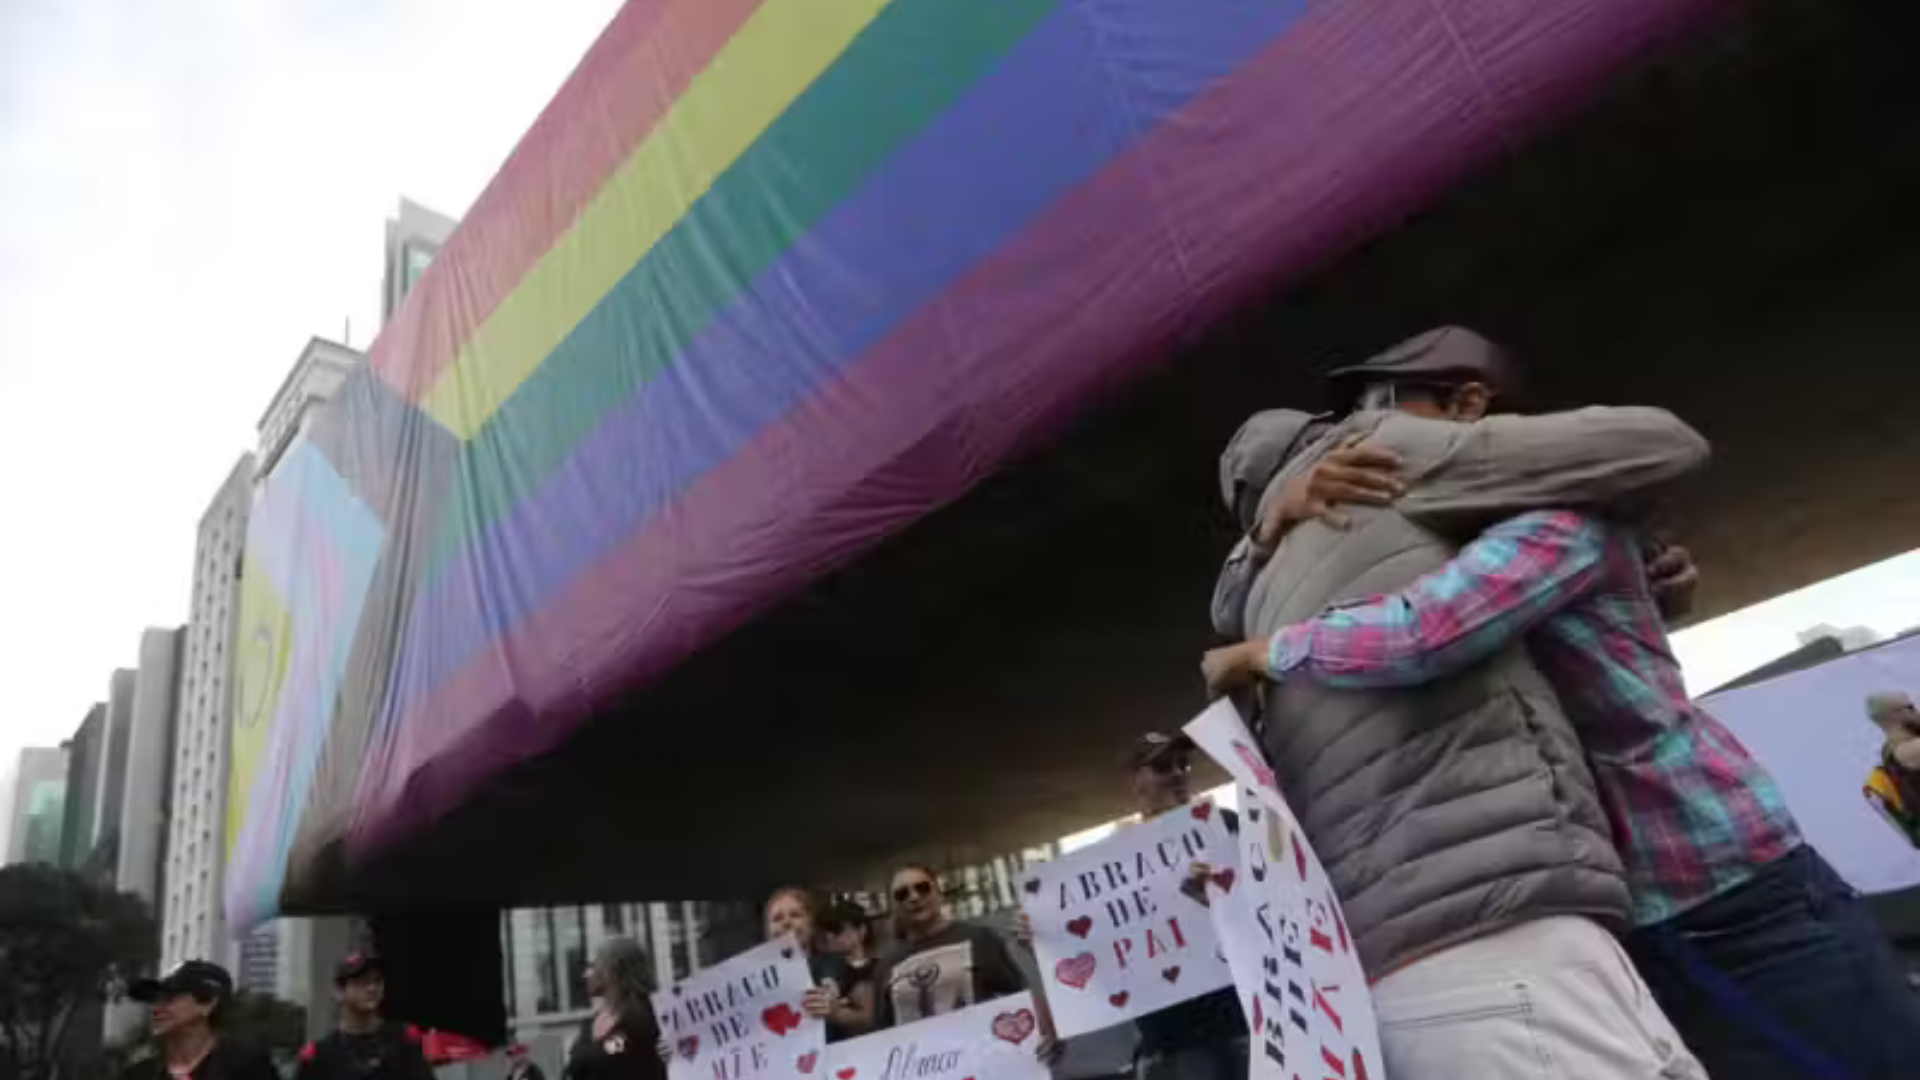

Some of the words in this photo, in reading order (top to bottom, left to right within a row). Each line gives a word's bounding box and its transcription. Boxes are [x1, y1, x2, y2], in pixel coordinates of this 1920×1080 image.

[1105, 885, 1158, 929] DE
[1112, 917, 1186, 969] PAI
[1279, 914, 1309, 1034] DE
[710, 1011, 750, 1047] DE
